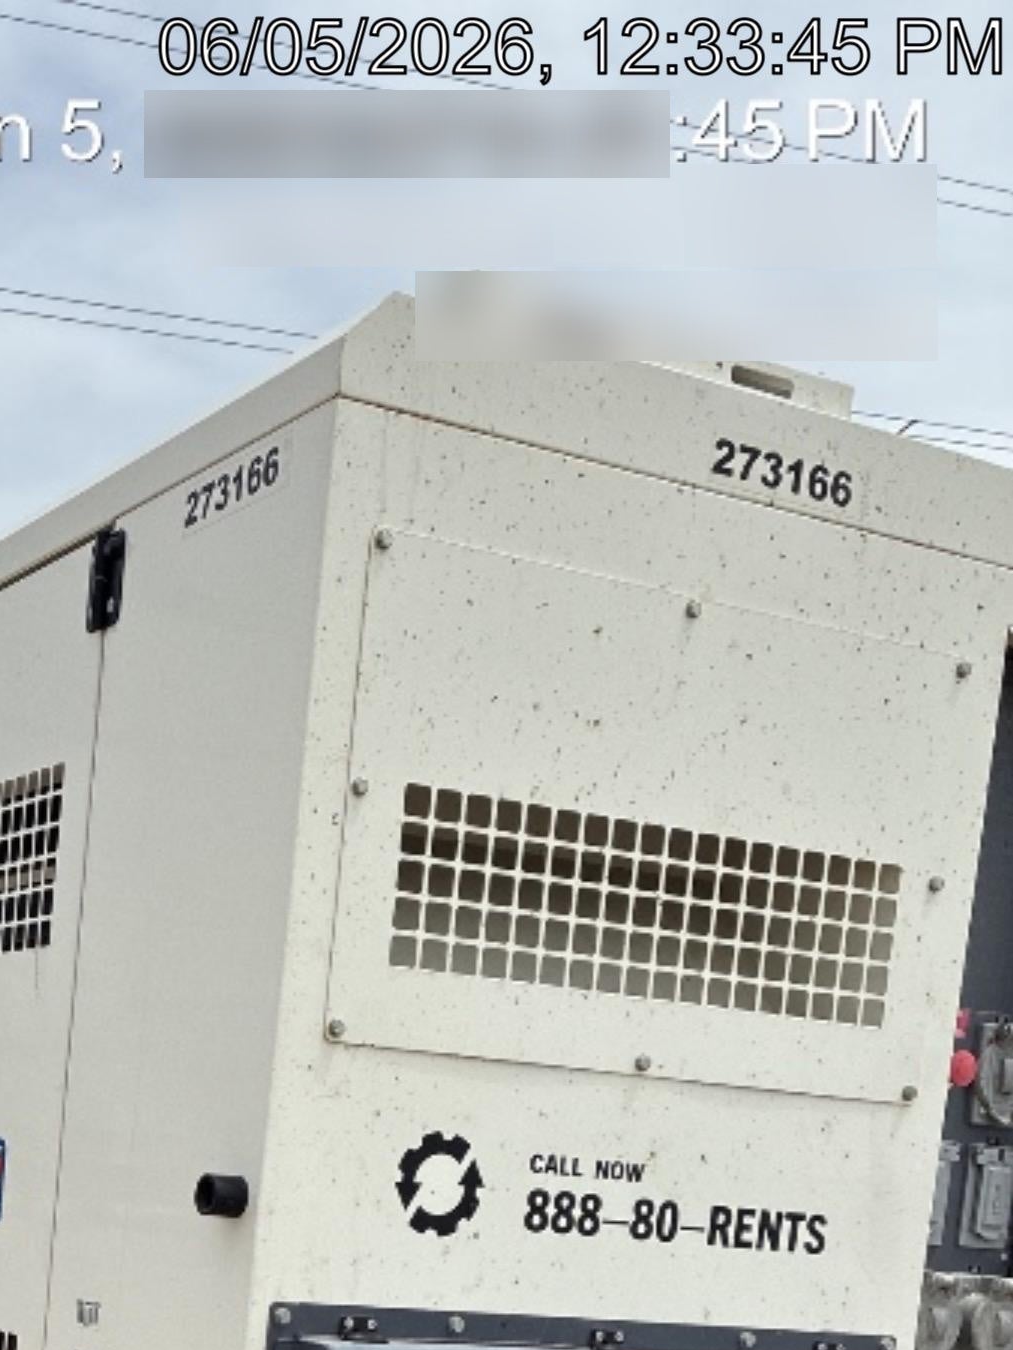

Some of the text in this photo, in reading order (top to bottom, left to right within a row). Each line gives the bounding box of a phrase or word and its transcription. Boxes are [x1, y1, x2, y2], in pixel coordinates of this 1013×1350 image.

[184, 446, 280, 529] 273166
[710, 437, 853, 508] 273166
[529, 1153, 647, 1184] CALL NOW
[523, 1187, 829, 1256] 888-80-RENTS
